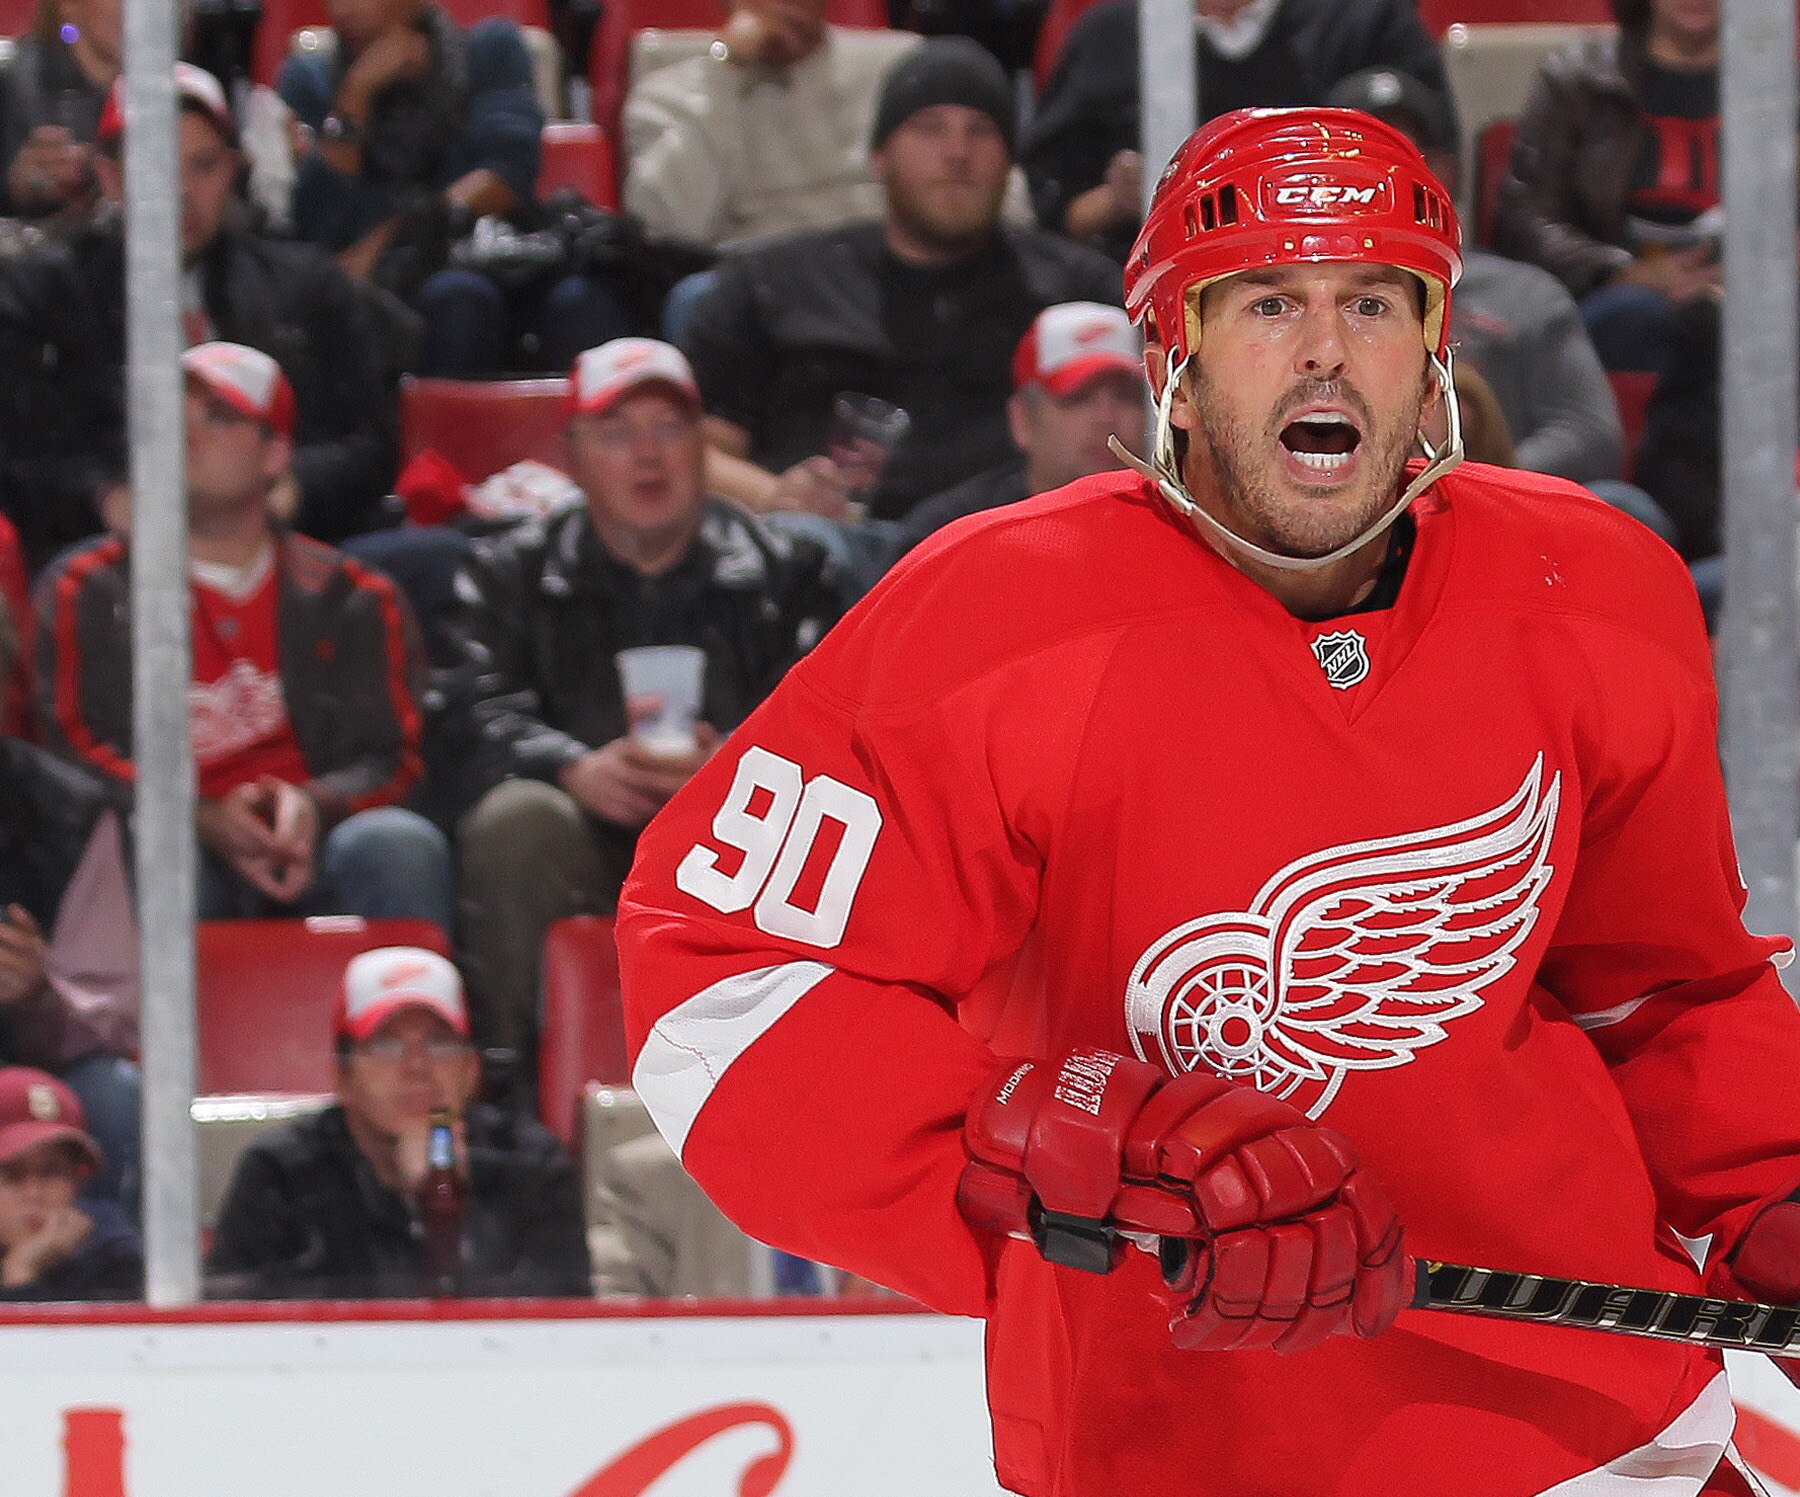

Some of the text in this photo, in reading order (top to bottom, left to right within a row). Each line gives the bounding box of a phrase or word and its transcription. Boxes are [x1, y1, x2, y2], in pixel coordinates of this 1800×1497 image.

[1276, 186, 1376, 205] CCM
[1326, 644, 1356, 677] NHL
[675, 745, 884, 949] 90
[995, 1062, 1035, 1106] MODANO
